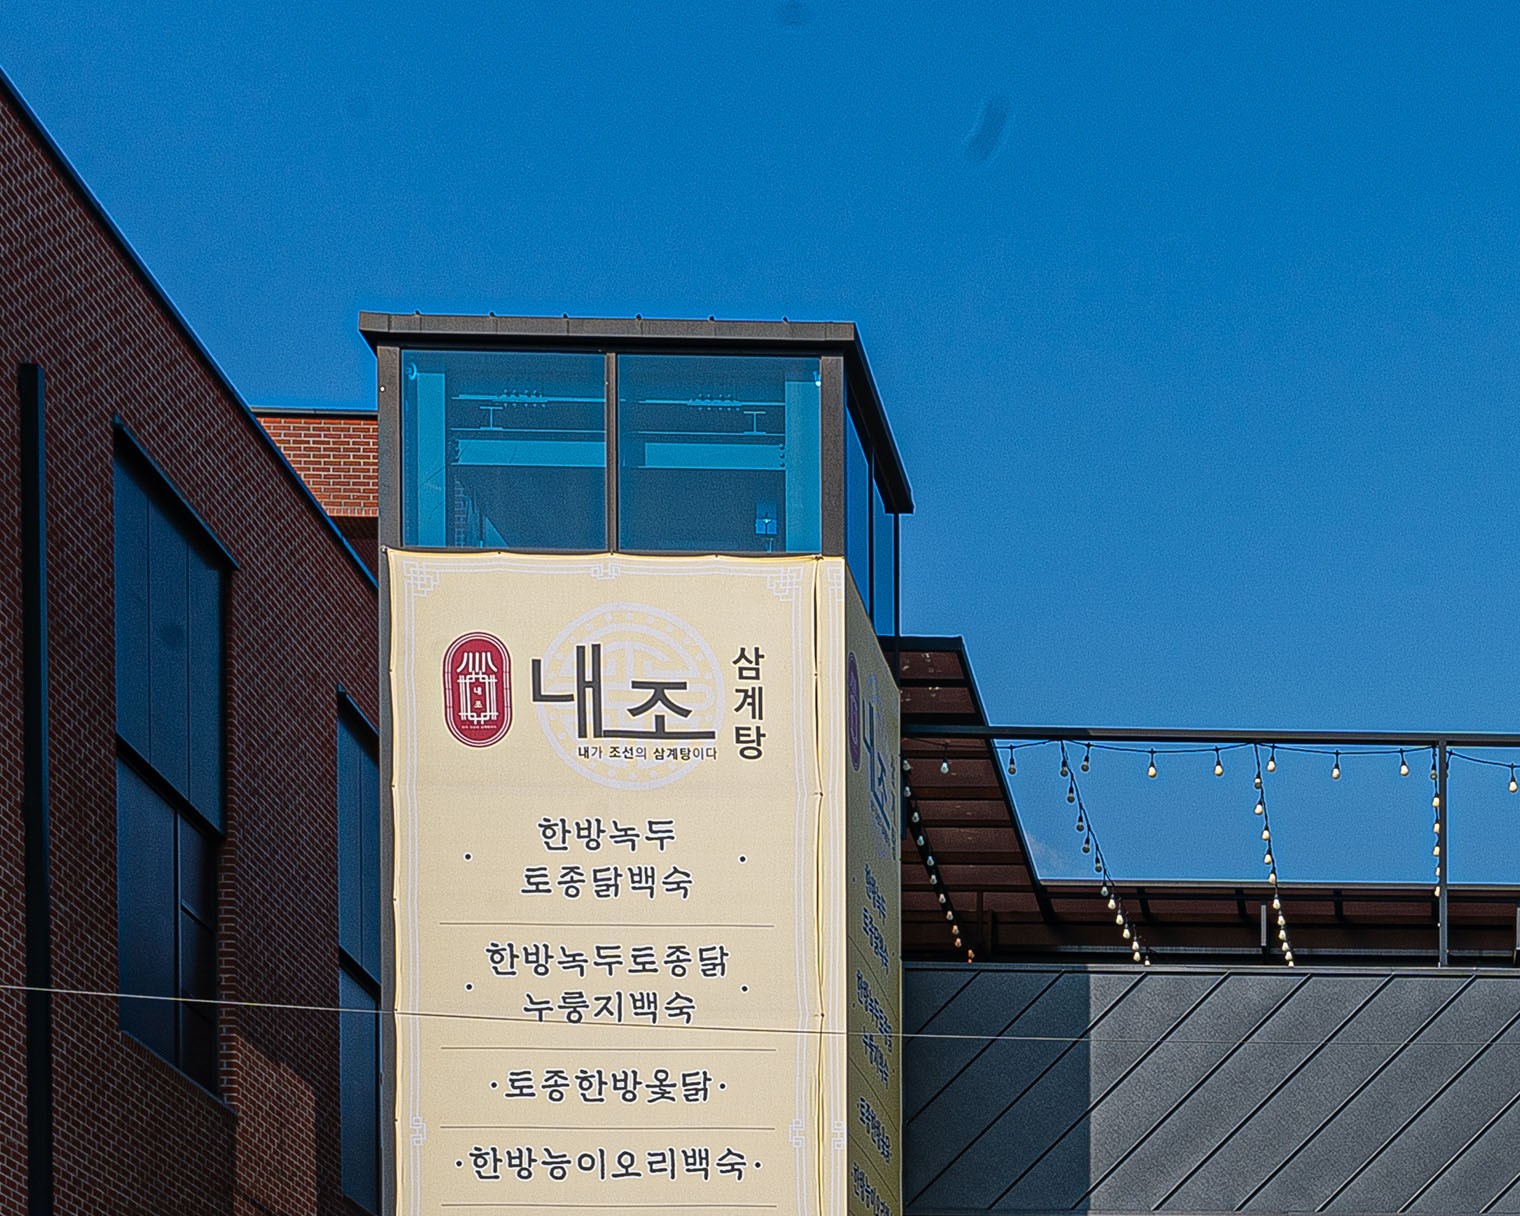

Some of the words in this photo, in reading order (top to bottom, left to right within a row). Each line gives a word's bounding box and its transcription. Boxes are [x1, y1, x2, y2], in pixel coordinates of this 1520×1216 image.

[531, 644, 716, 739] 내조
[732, 647, 766, 760] 삼계탕
[578, 746, 603, 759] 내가
[609, 746, 647, 760] 조선의
[653, 747, 717, 761] 삼계탕이다
[538, 817, 675, 851] 한방녹두
[521, 866, 693, 899] 토종닭백숙
[485, 943, 730, 978] 한방녹두토종닭
[523, 991, 695, 1024] 누룽지백숙
[504, 1069, 713, 1103] 토종한방옻닭
[469, 1147, 747, 1181] 한방능이오리백숙
